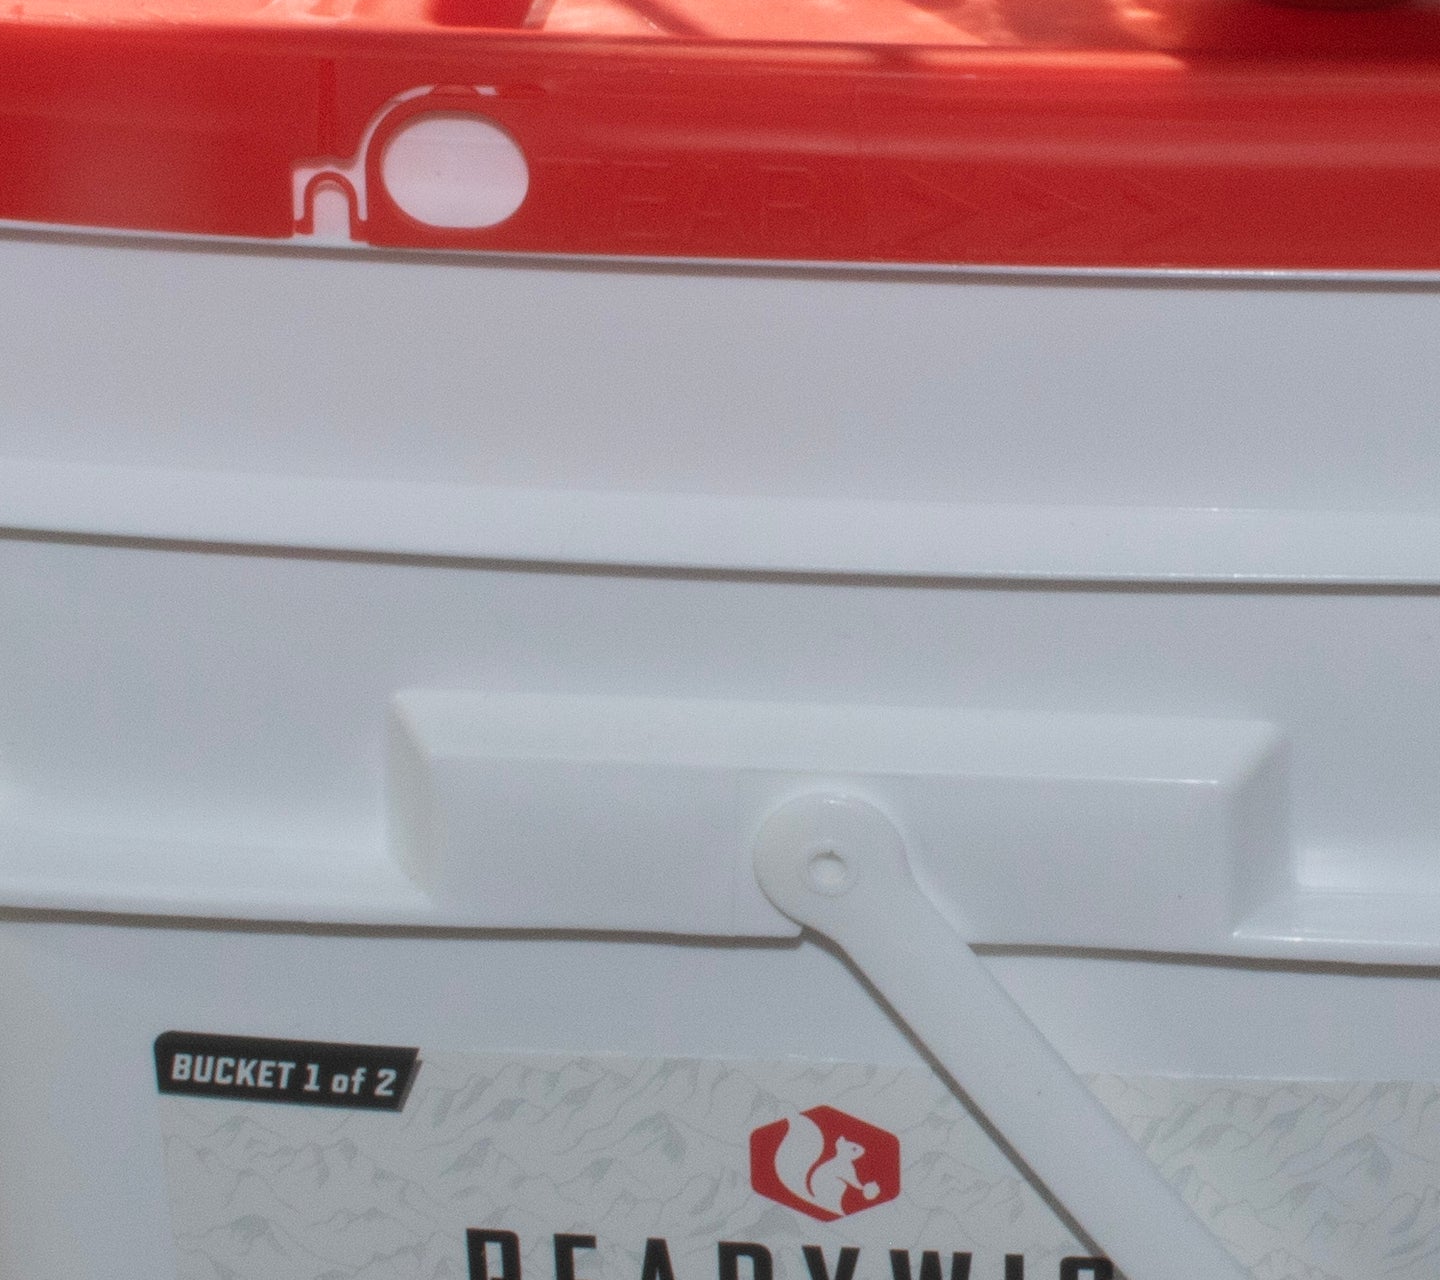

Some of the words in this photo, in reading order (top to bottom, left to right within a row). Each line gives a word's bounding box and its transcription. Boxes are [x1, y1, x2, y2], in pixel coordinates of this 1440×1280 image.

[171, 1053, 296, 1089] BUCKET
[303, 1064, 320, 1092] 1
[331, 1067, 366, 1094] of
[374, 1069, 397, 1097] 2
